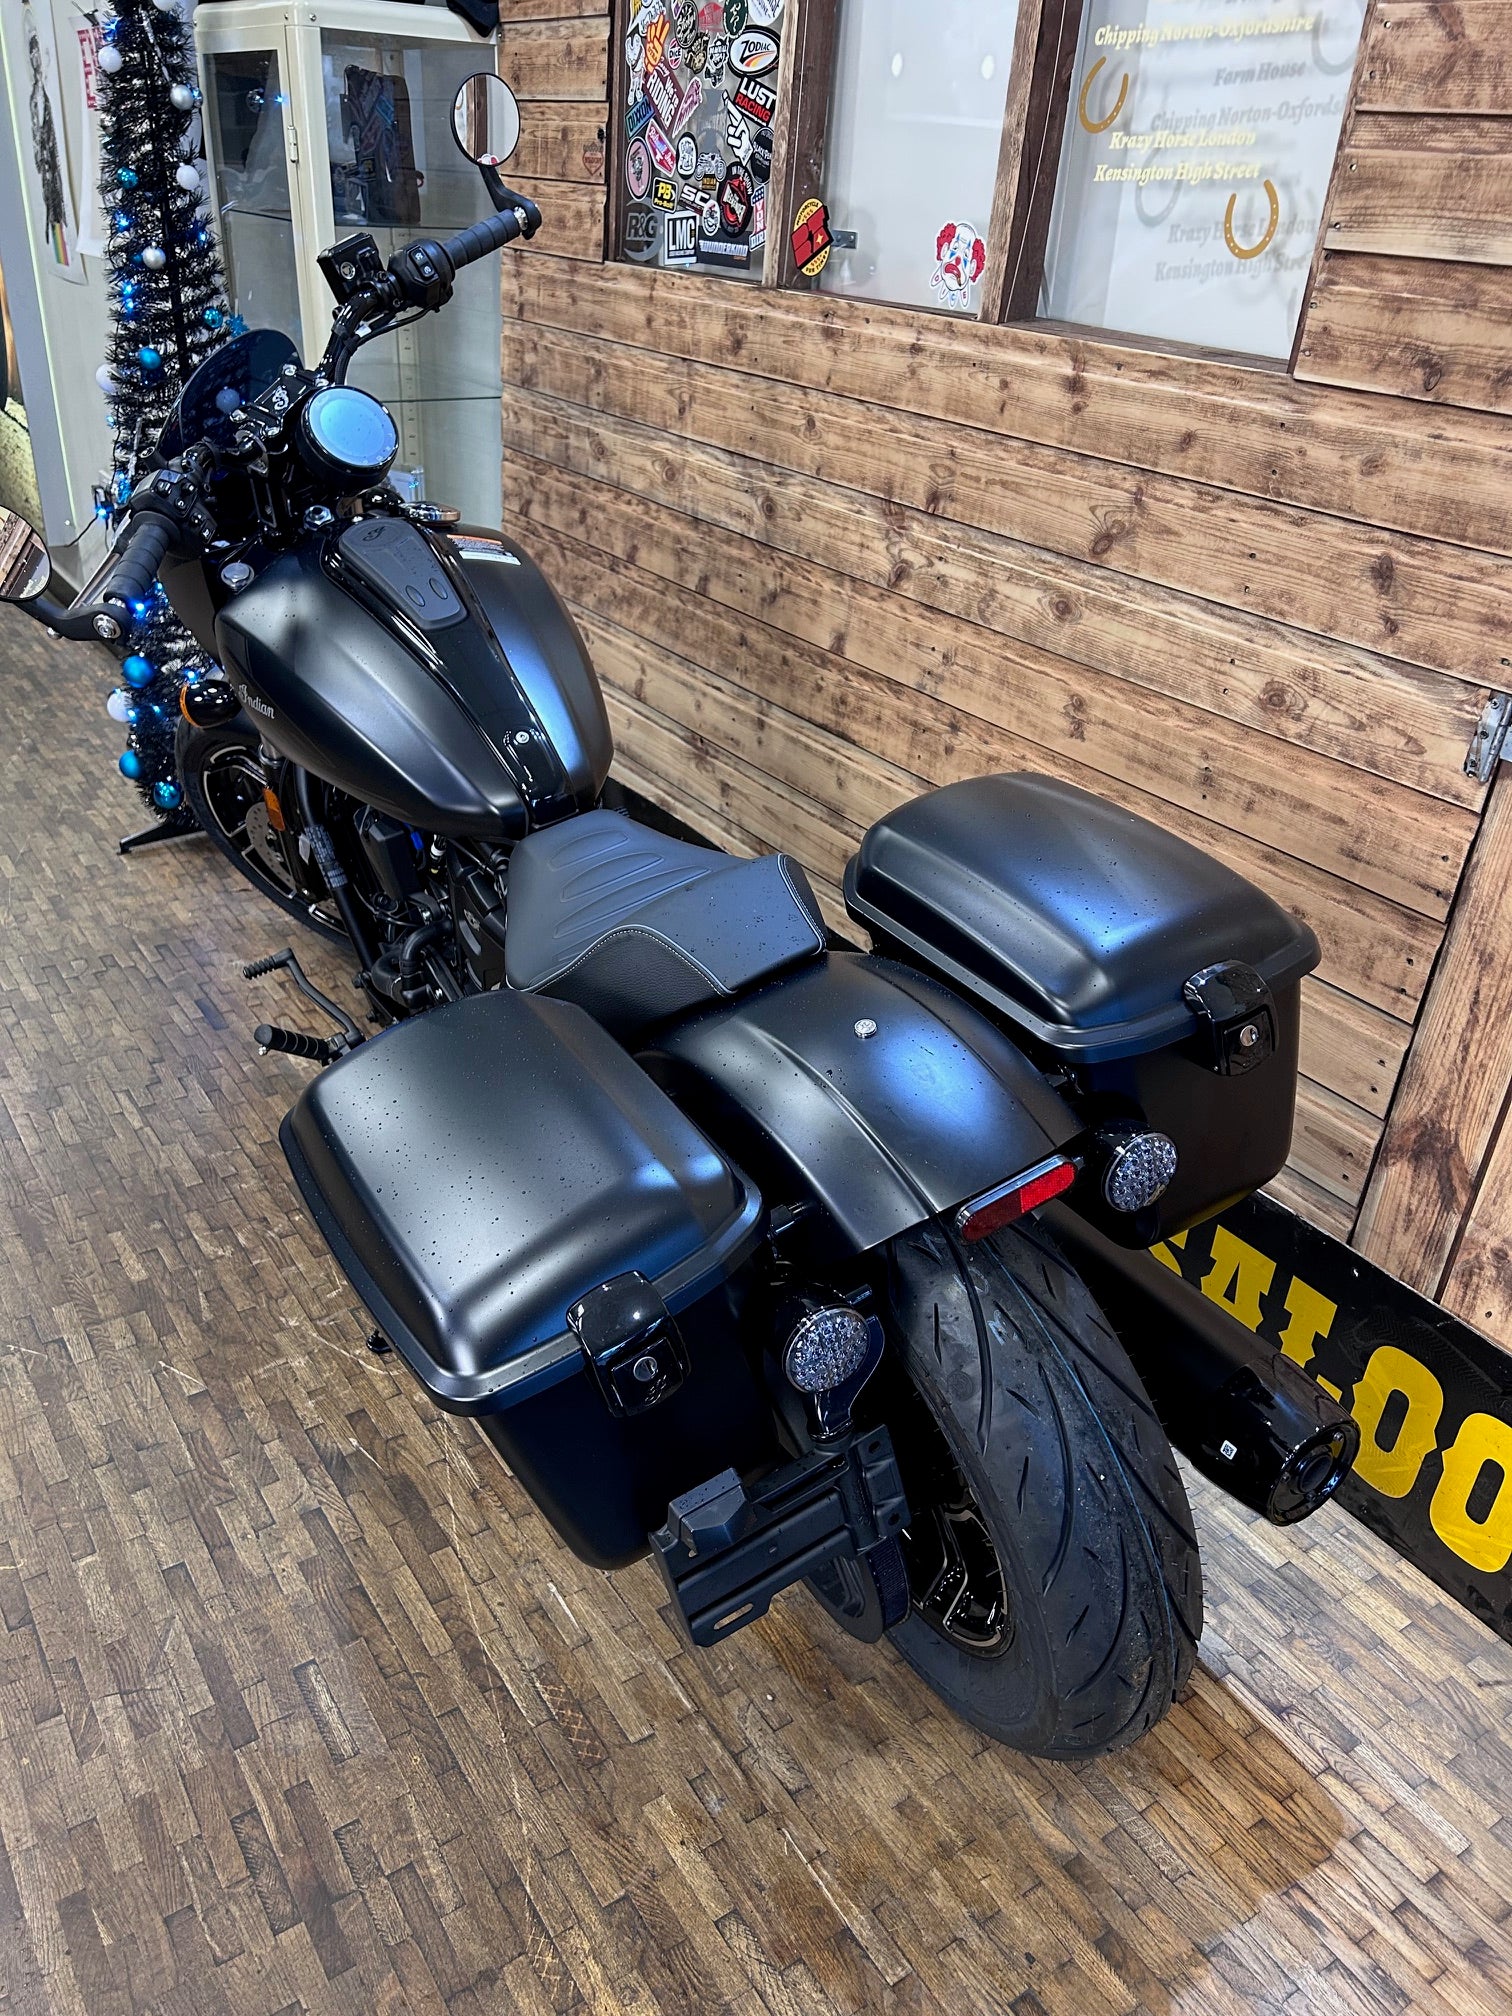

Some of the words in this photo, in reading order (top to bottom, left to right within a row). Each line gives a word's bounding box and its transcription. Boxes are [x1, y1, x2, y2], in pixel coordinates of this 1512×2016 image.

[1094, 23, 1158, 49] Chipping
[1159, 15, 1314, 43] Norton-Oxfordshire
[669, 48, 681, 57] DICE
[740, 40, 772, 64] ZODIAC
[1214, 67, 1255, 86] Farm
[1256, 61, 1306, 81] House
[647, 69, 675, 128] RIDING
[739, 77, 777, 109] LUST
[735, 92, 771, 121] RACING
[1151, 112, 1216, 136] Chipping
[1109, 131, 1153, 153] Krazy
[1153, 130, 1200, 149] Horse
[1200, 128, 1256, 147] London
[1093, 163, 1173, 186] Kensington
[1175, 161, 1213, 184] High
[1213, 162, 1261, 179] Street
[658, 182, 672, 200] PB
[626, 213, 658, 240] R&G
[669, 219, 695, 250] LMC
[1168, 223, 1211, 245] Krazy
[1212, 220, 1257, 241] Hrse
[238, 684, 275, 719] Indian
[1149, 1225, 1512, 1573] ALOO
